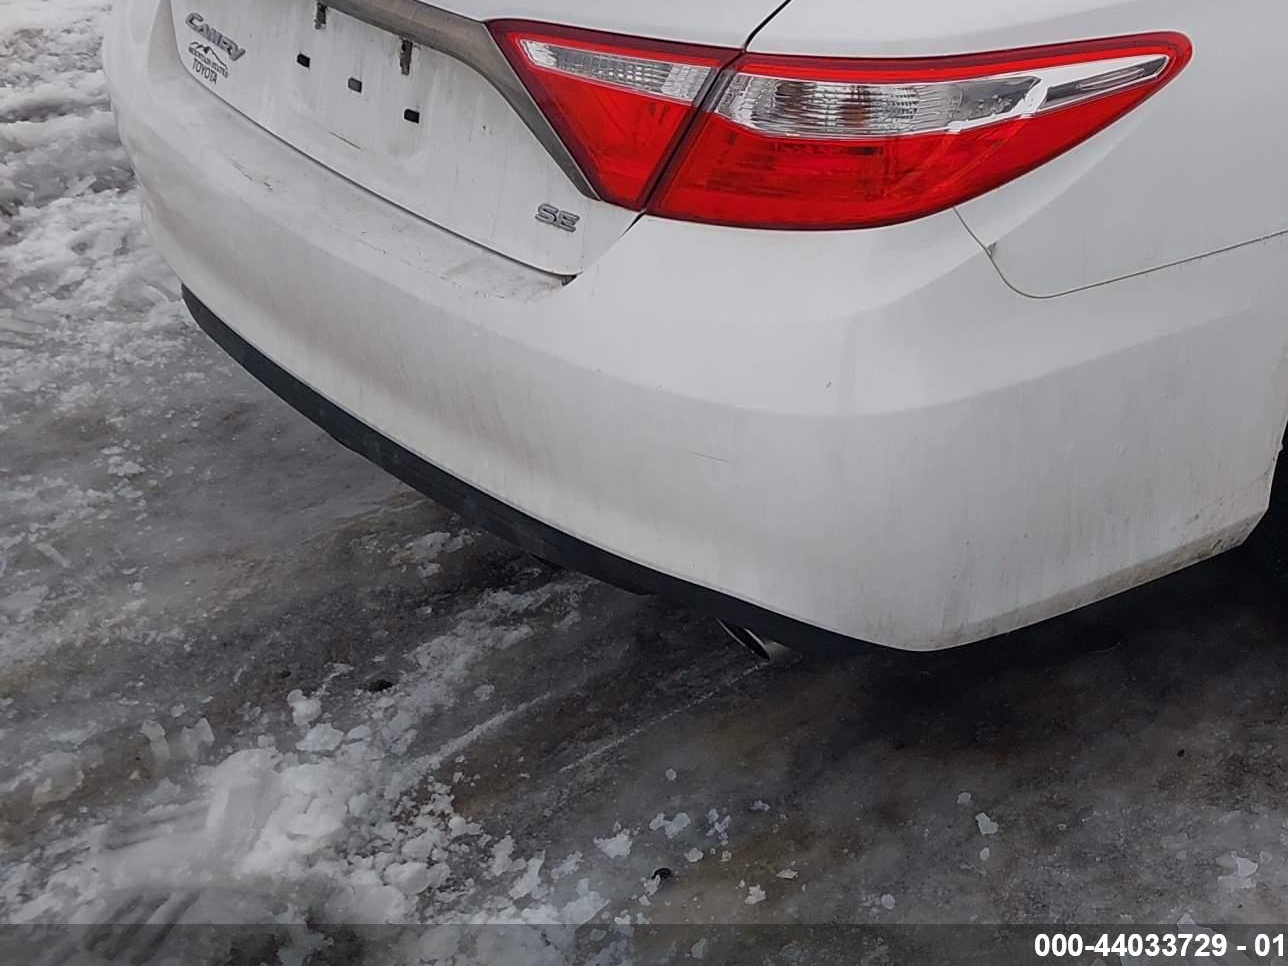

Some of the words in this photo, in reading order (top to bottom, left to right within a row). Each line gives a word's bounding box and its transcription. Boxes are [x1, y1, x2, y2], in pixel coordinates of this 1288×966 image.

[185, 12, 246, 61] CAMRY
[192, 57, 218, 85] TOYOTA
[534, 203, 581, 232] SE
